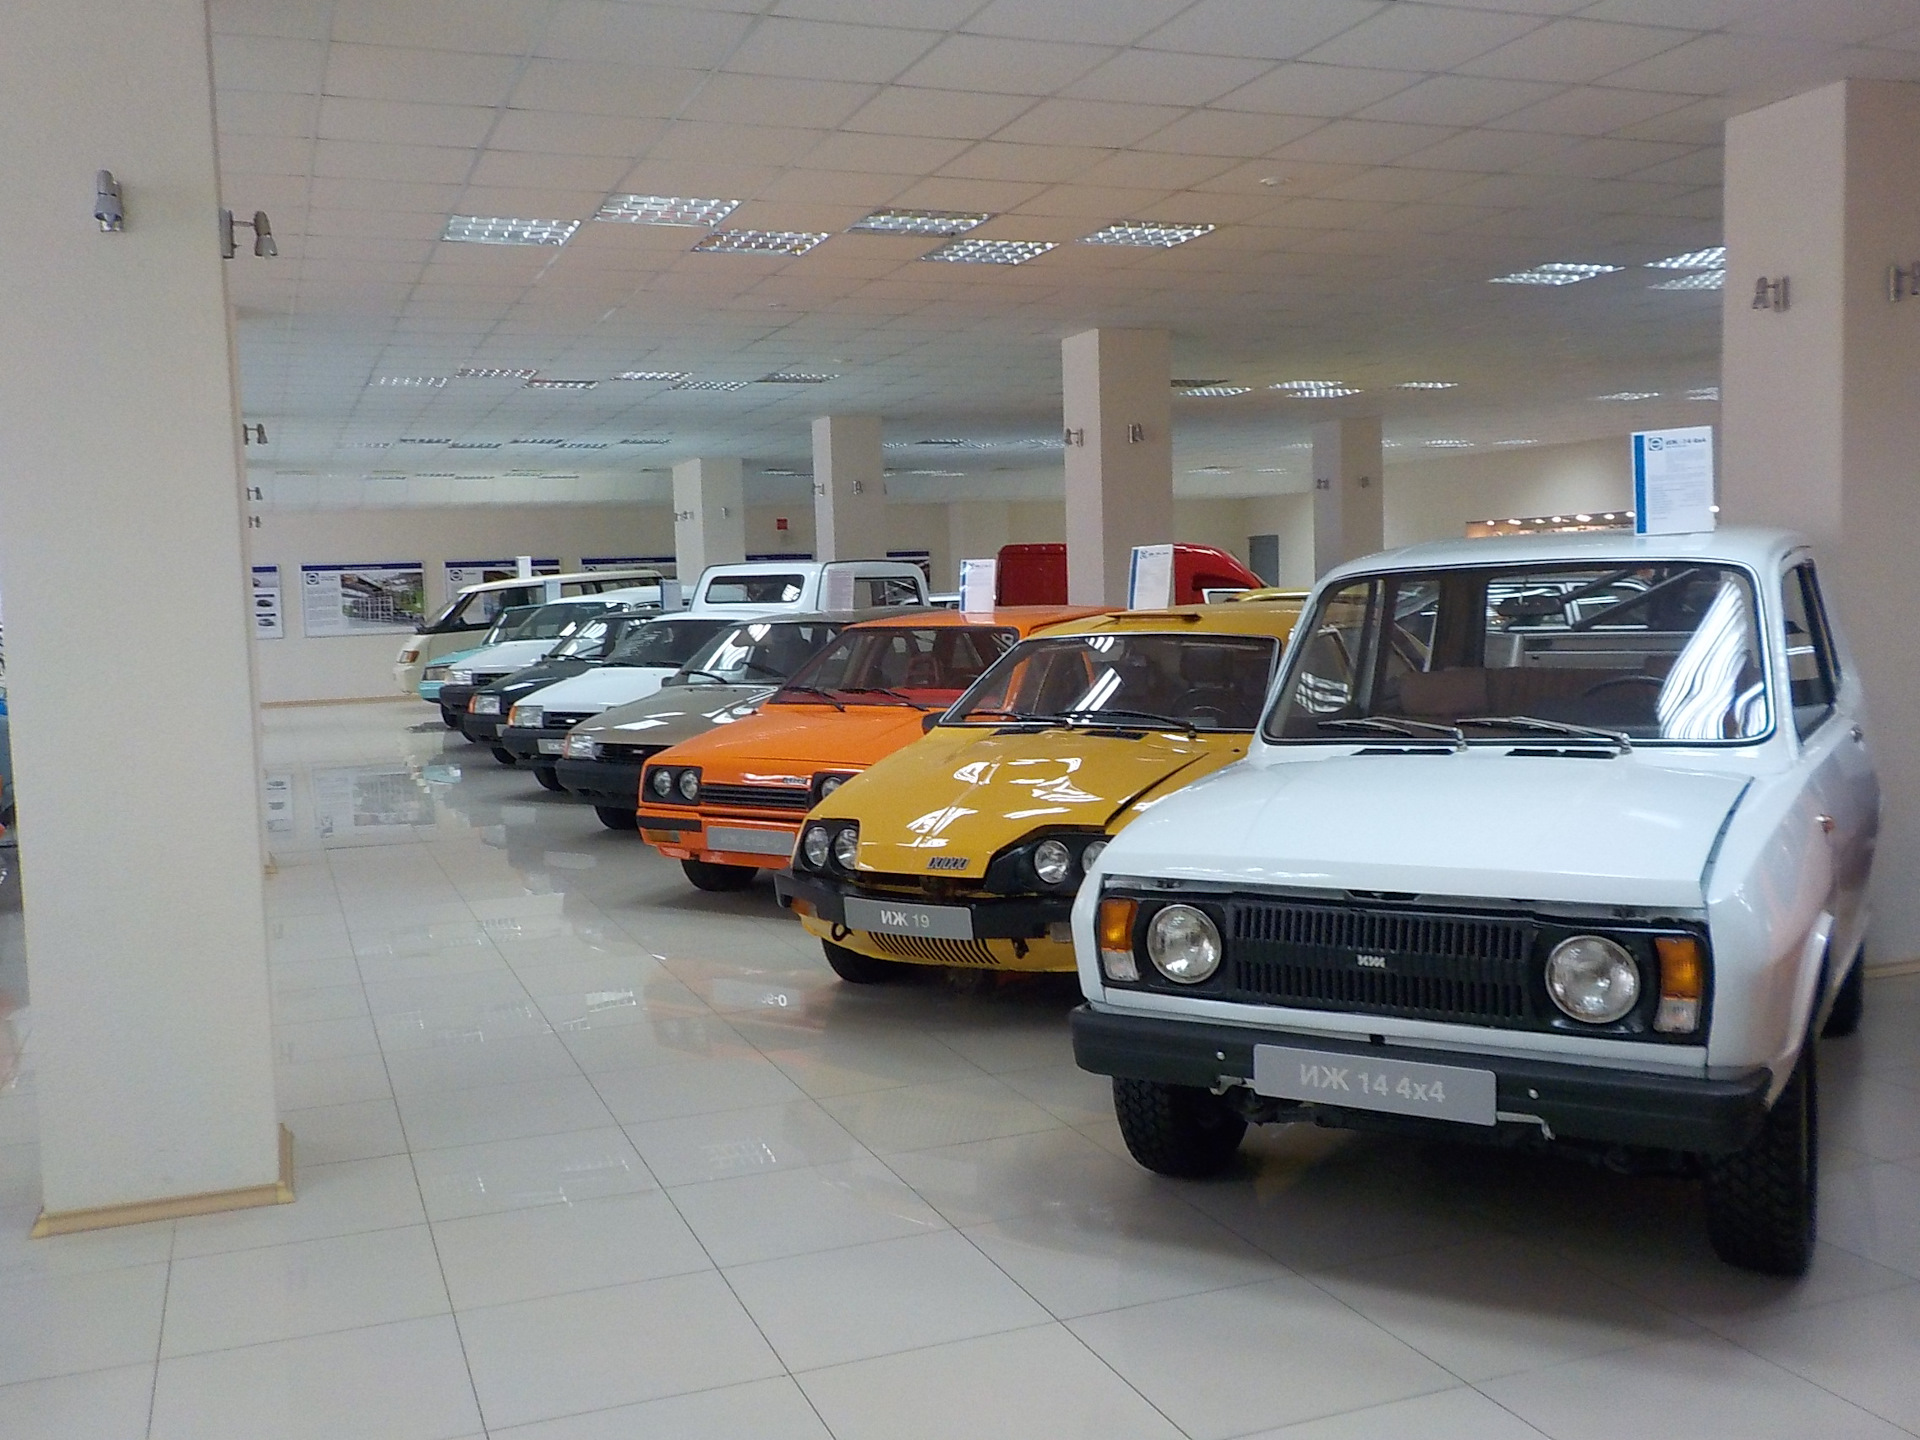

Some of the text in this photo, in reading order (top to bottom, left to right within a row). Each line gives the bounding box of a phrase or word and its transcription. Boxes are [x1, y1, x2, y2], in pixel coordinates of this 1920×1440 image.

[880, 909, 930, 928] ИЖ 19
[1300, 1063, 1446, 1104] ИЖ 14 4x4
